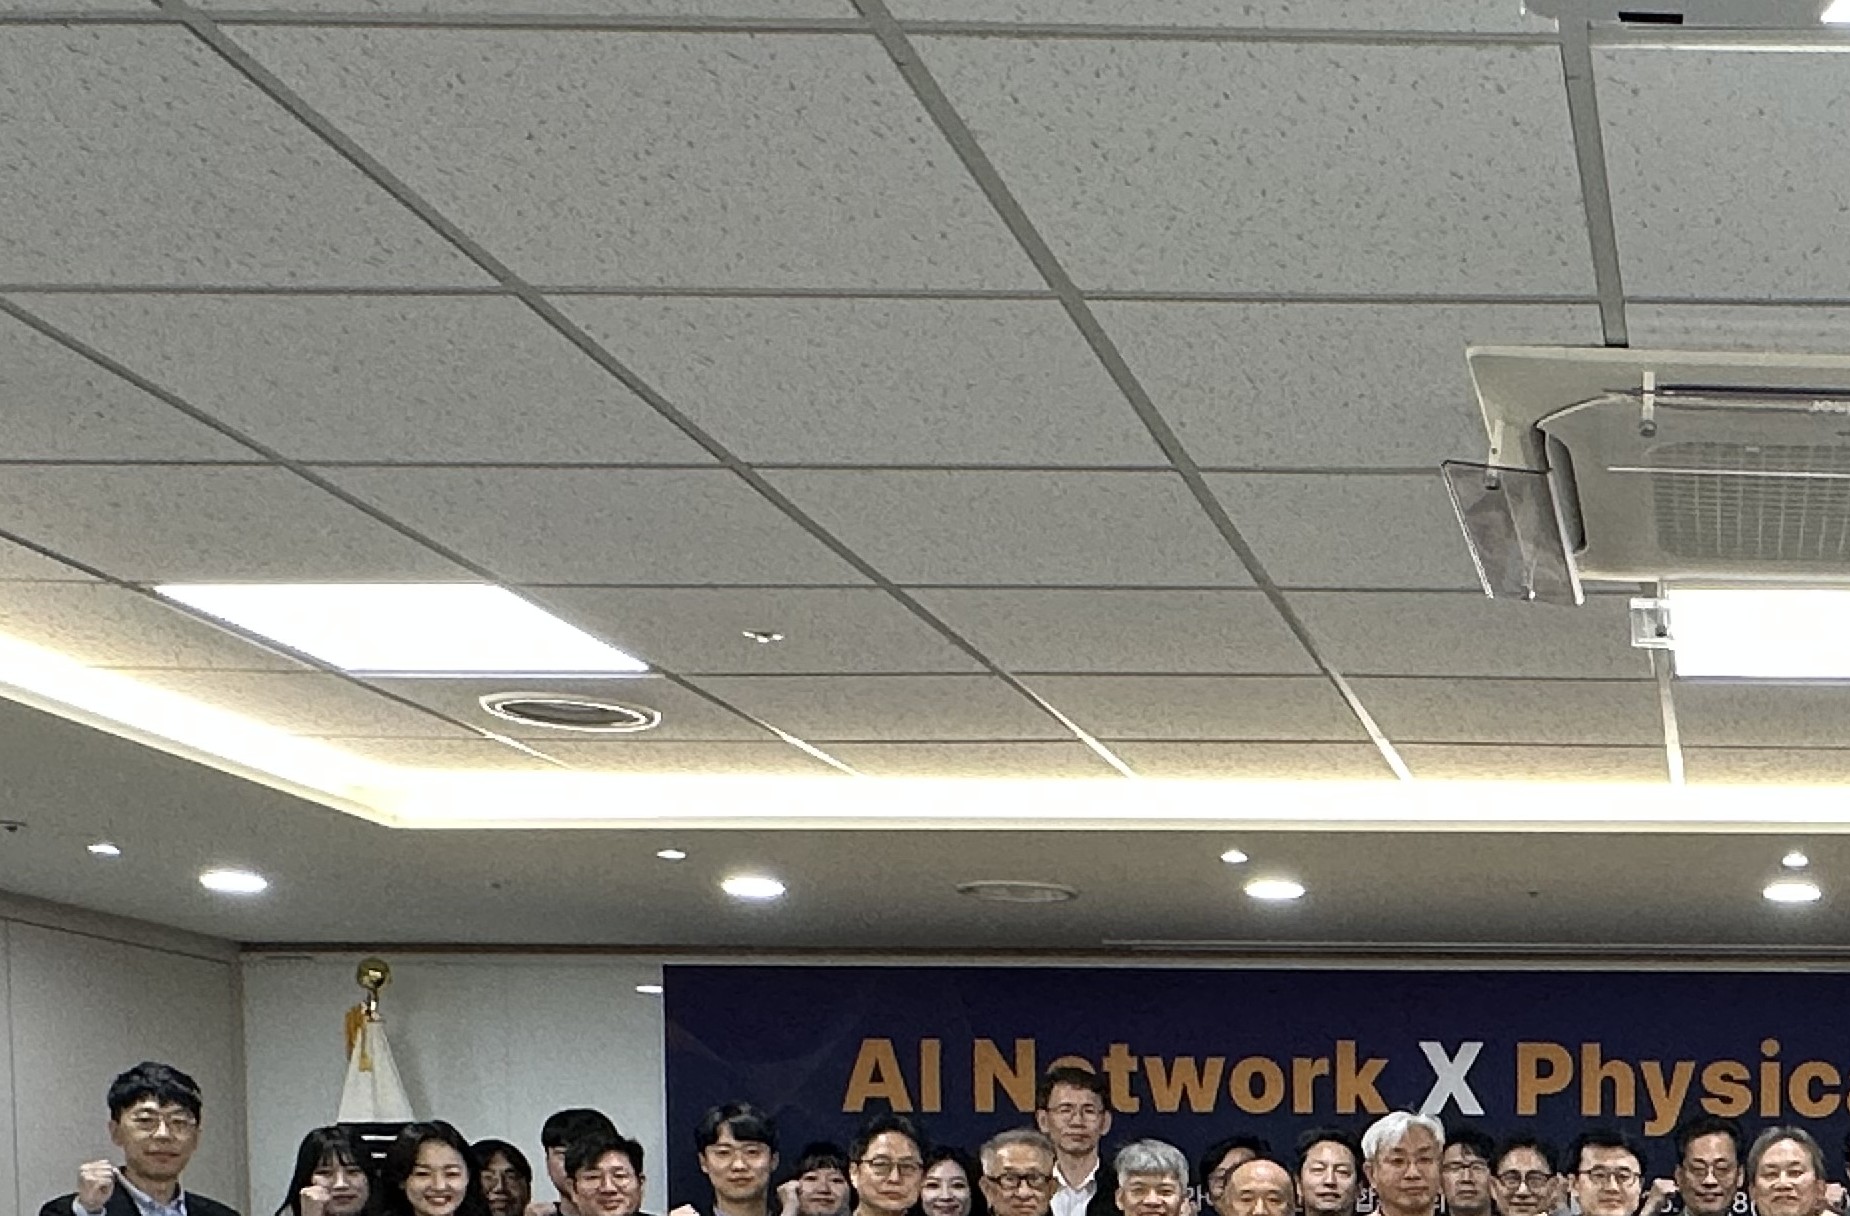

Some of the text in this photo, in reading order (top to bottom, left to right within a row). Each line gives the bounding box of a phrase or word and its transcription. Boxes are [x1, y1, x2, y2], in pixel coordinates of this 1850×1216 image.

[842, 1036, 941, 1112] AI
[973, 1037, 1389, 1115] Ntwork
[1415, 1040, 1484, 1115] X
